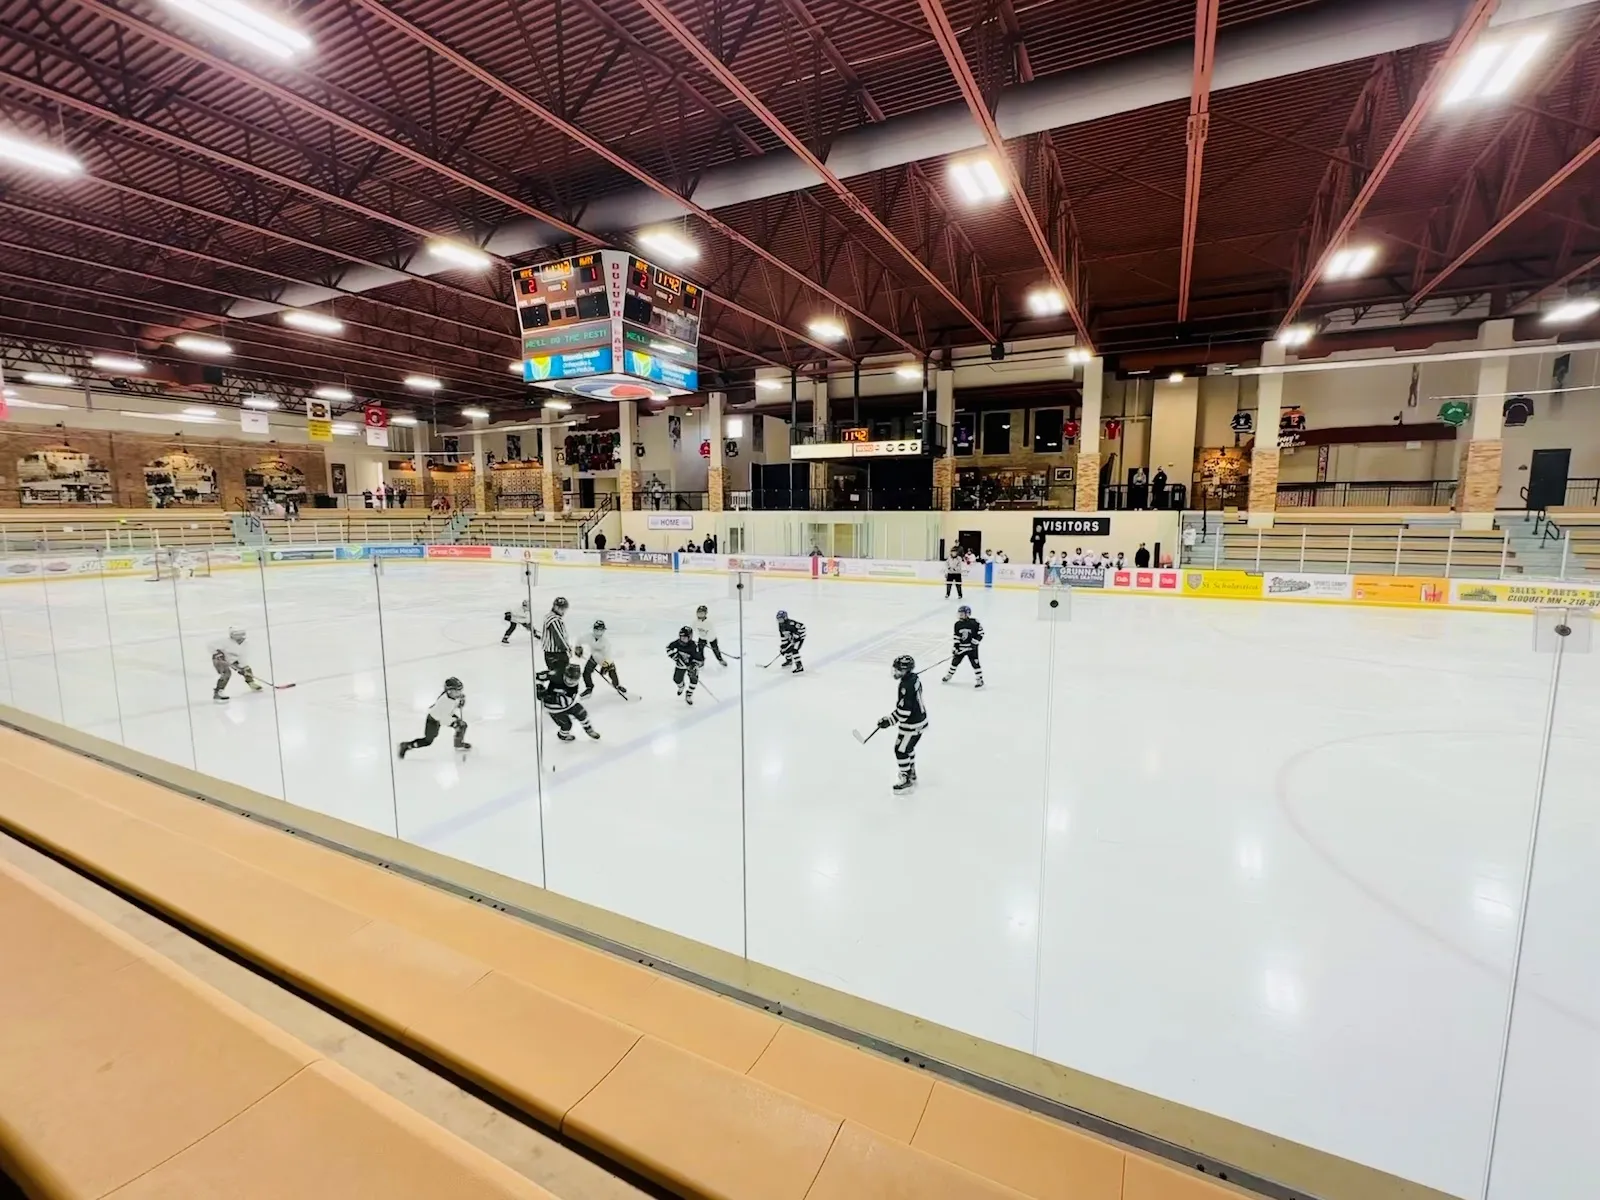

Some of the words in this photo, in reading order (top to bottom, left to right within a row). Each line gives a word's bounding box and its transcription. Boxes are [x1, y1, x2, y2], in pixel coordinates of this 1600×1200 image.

[528, 280, 534, 292] 2
[561, 281, 567, 291] 2
[640, 274, 647, 288] 2
[658, 273, 679, 292] 11:42
[612, 263, 620, 317] DULUTH
[667, 294, 673, 304] 2
[584, 329, 606, 339] REST!
[614, 328, 622, 361] EAST
[845, 431, 867, 440] 11:42
[1043, 521, 1099, 532] VISITORS
[639, 553, 669, 564] TAVERN
[1509, 586, 1537, 594] SALES
[1546, 588, 1578, 597] PARTS
